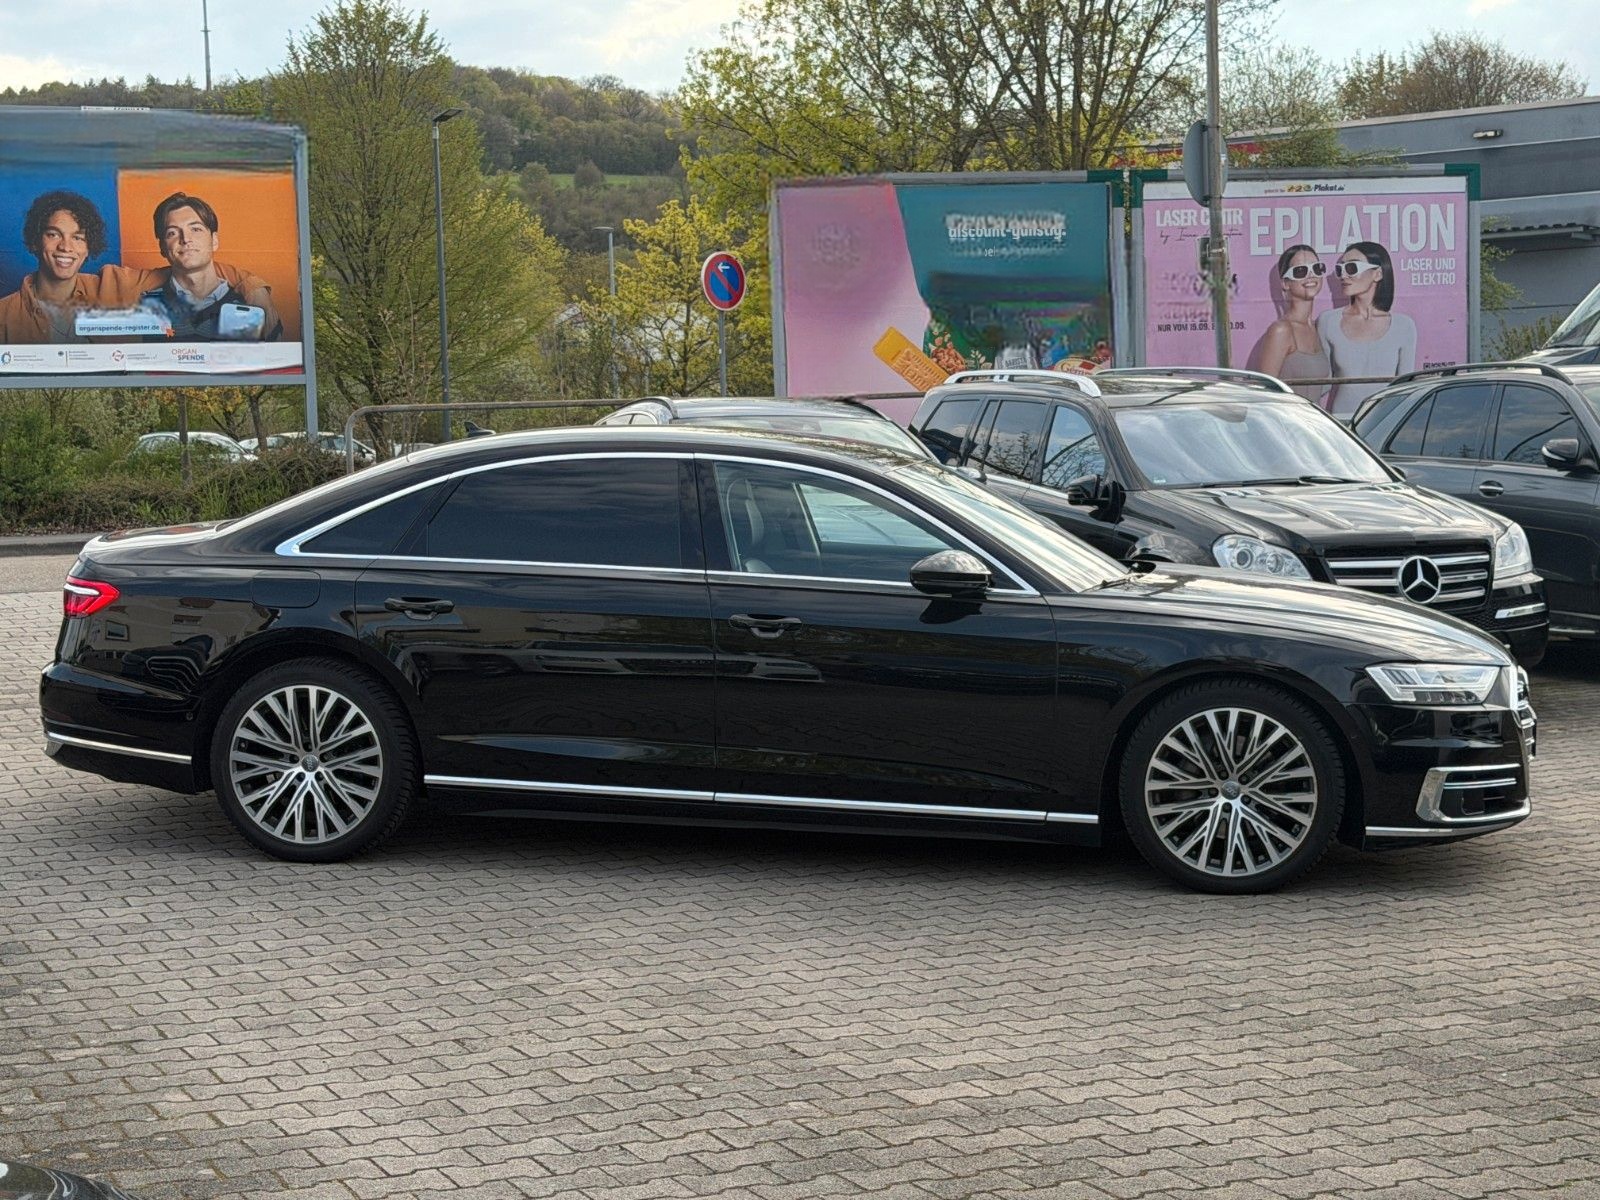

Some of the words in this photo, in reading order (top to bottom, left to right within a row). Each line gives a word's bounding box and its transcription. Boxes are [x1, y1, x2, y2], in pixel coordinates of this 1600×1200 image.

[1156, 209, 1198, 227] LASER
[1250, 203, 1455, 256] EPILATION
[1400, 257, 1432, 271] LASER
[1435, 257, 1456, 270] UND
[1411, 272, 1456, 286] ELEKTRO
[79, 324, 160, 332] organspende-register.de
[1157, 323, 1171, 332] NUR
[1172, 323, 1188, 332] VOM
